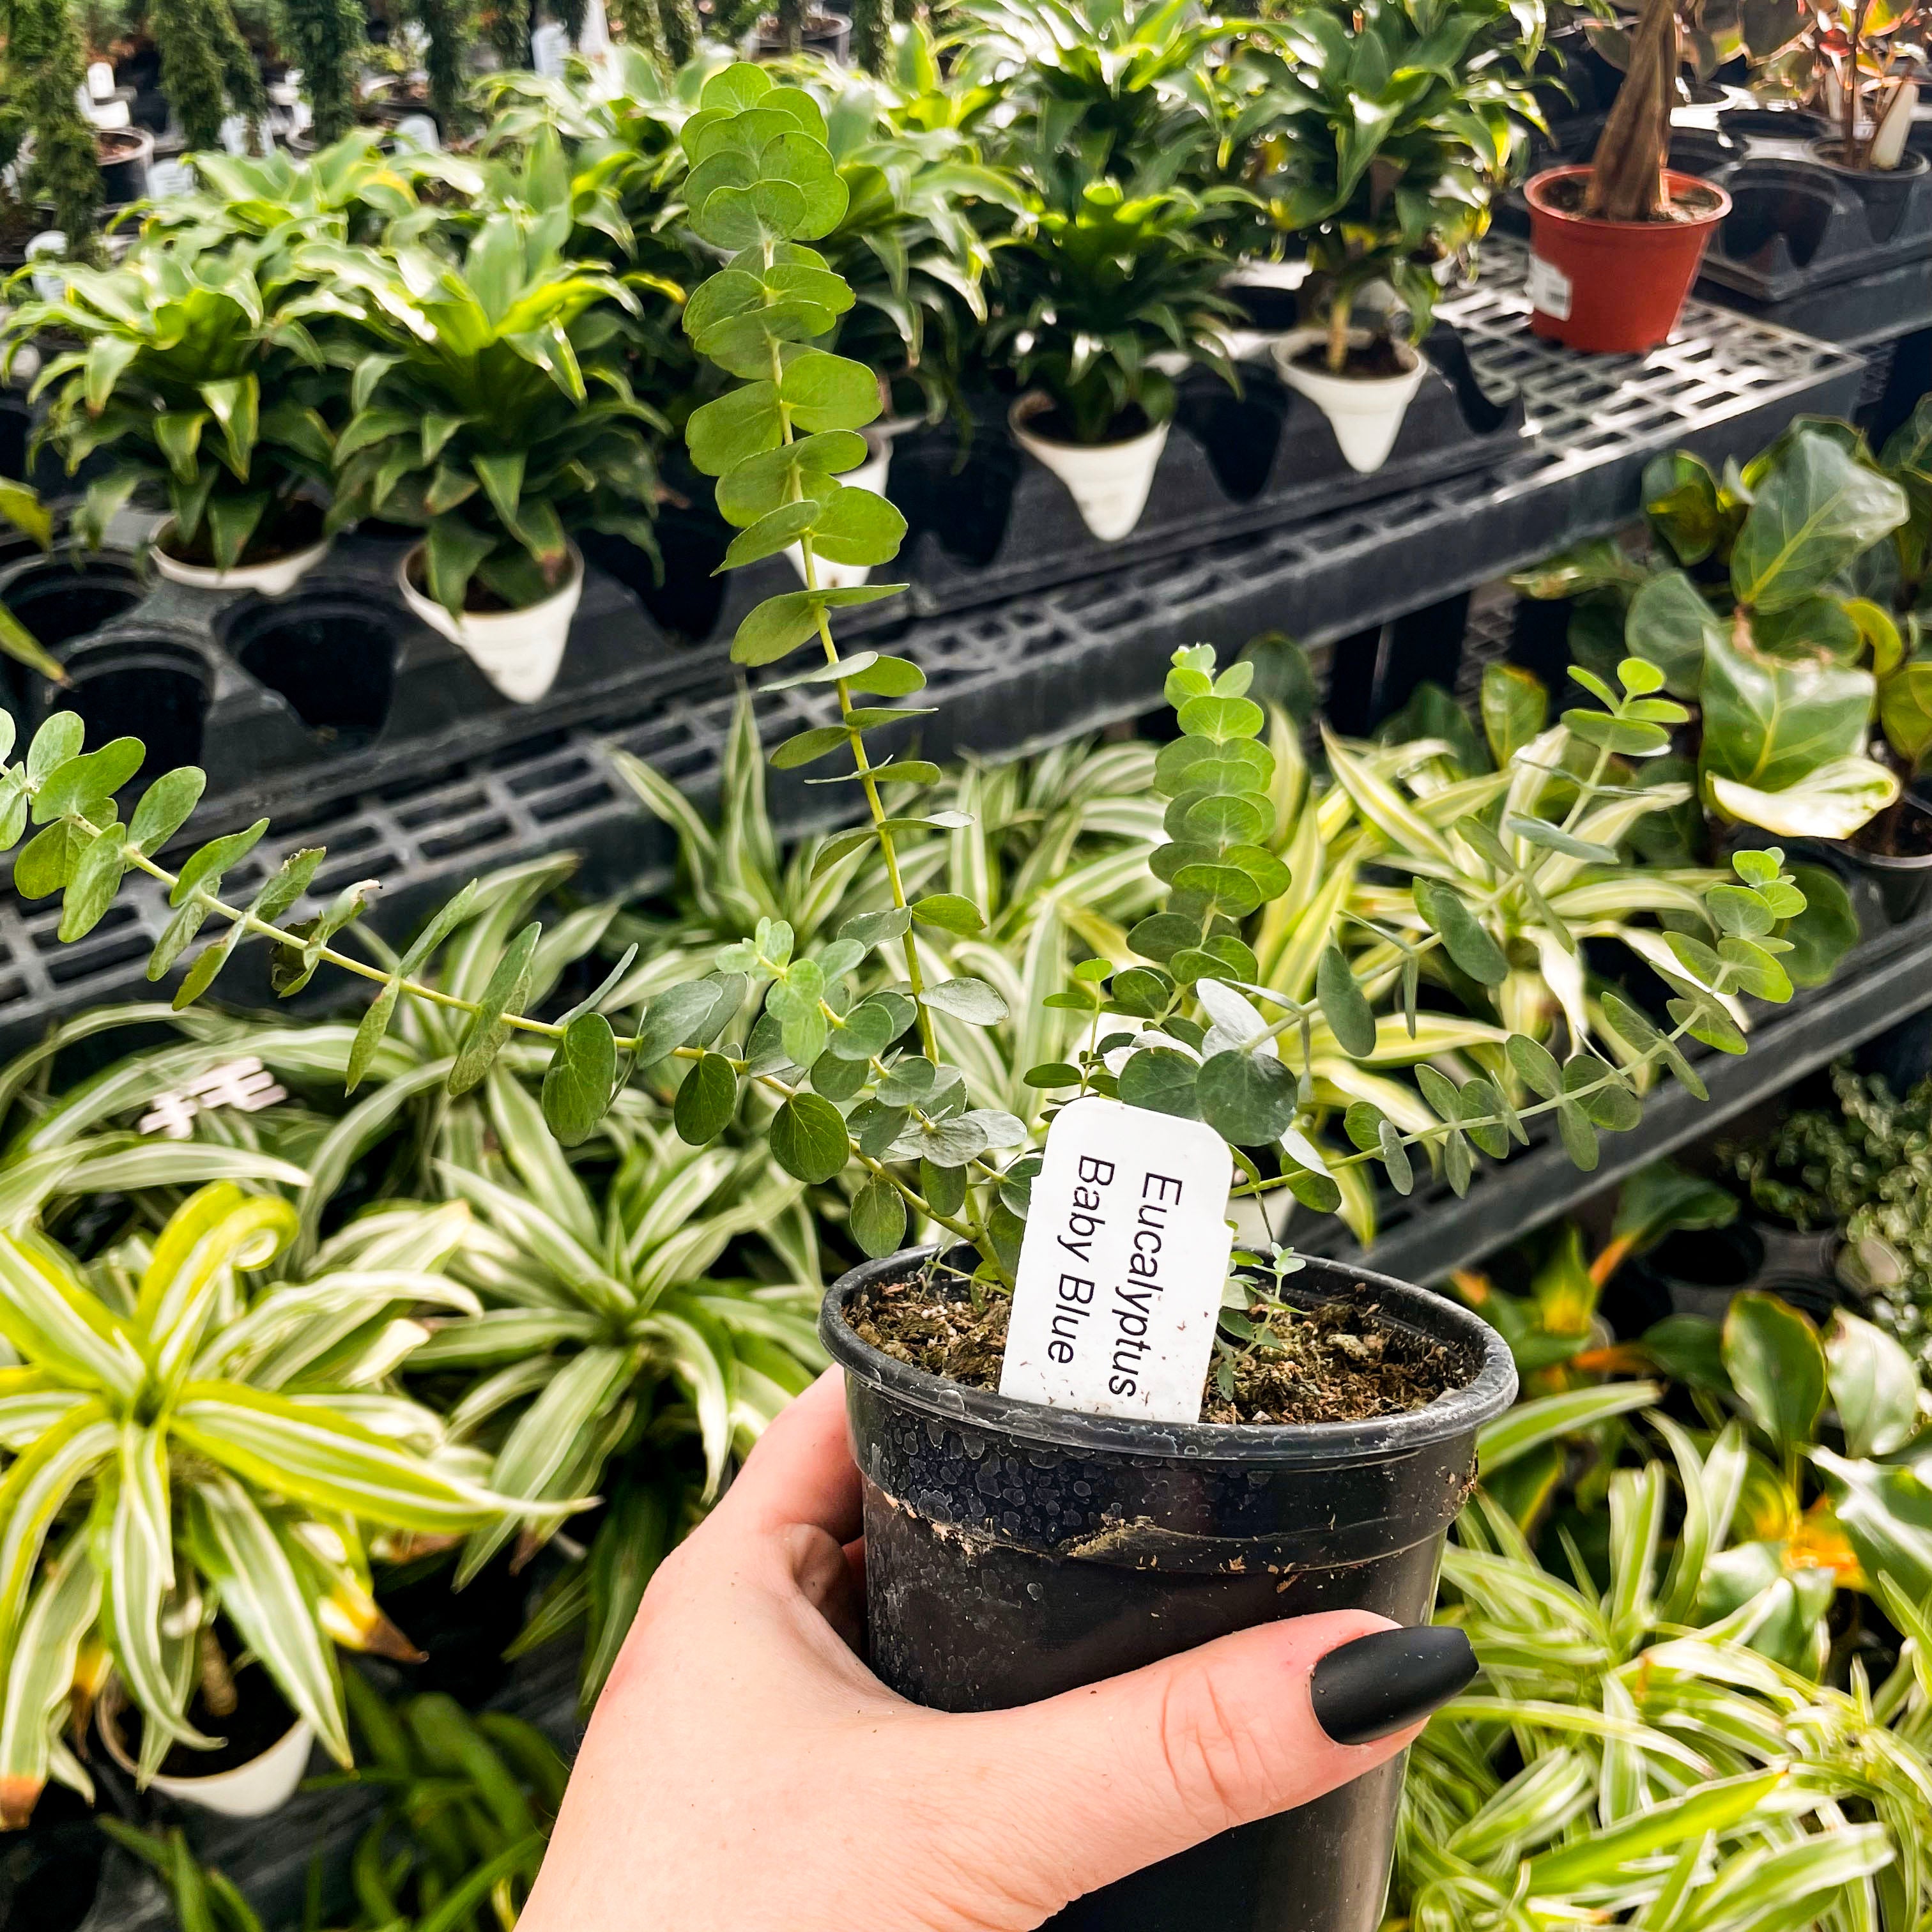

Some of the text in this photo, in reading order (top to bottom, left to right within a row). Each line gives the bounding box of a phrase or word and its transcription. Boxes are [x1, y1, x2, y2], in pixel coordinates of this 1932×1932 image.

[1048, 1155, 1115, 1363] Baby Blue
[1108, 1172, 1183, 1397] Eucalyptus
